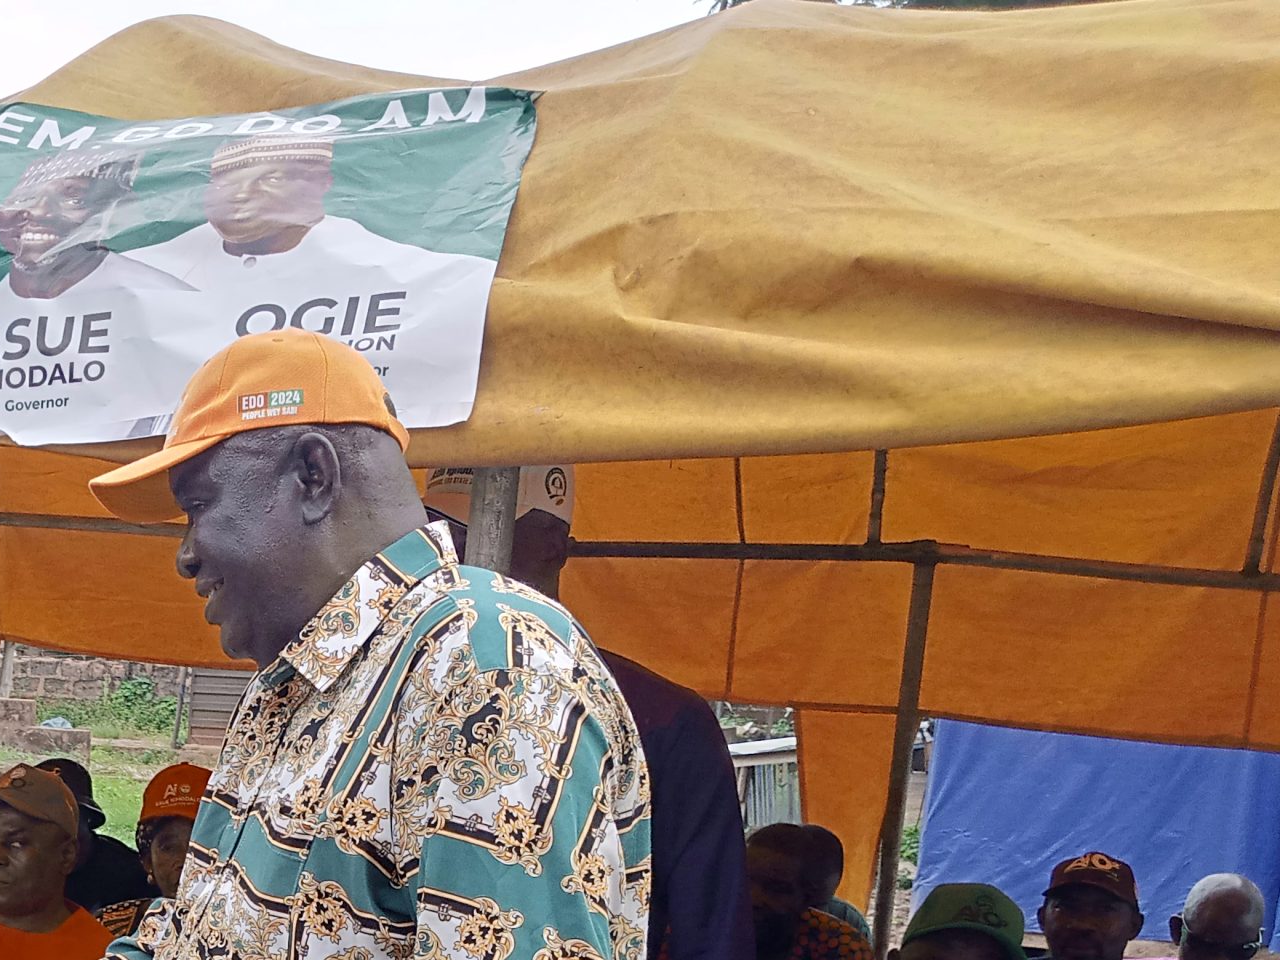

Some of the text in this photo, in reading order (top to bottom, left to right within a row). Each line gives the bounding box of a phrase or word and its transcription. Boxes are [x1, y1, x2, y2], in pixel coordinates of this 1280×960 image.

[112, 122, 213, 143] GO
[232, 112, 342, 134] DO
[358, 86, 487, 132] AM
[235, 291, 407, 337] OGIE
[4, 396, 70, 412] Governor
[242, 390, 301, 410] EDO 2024
